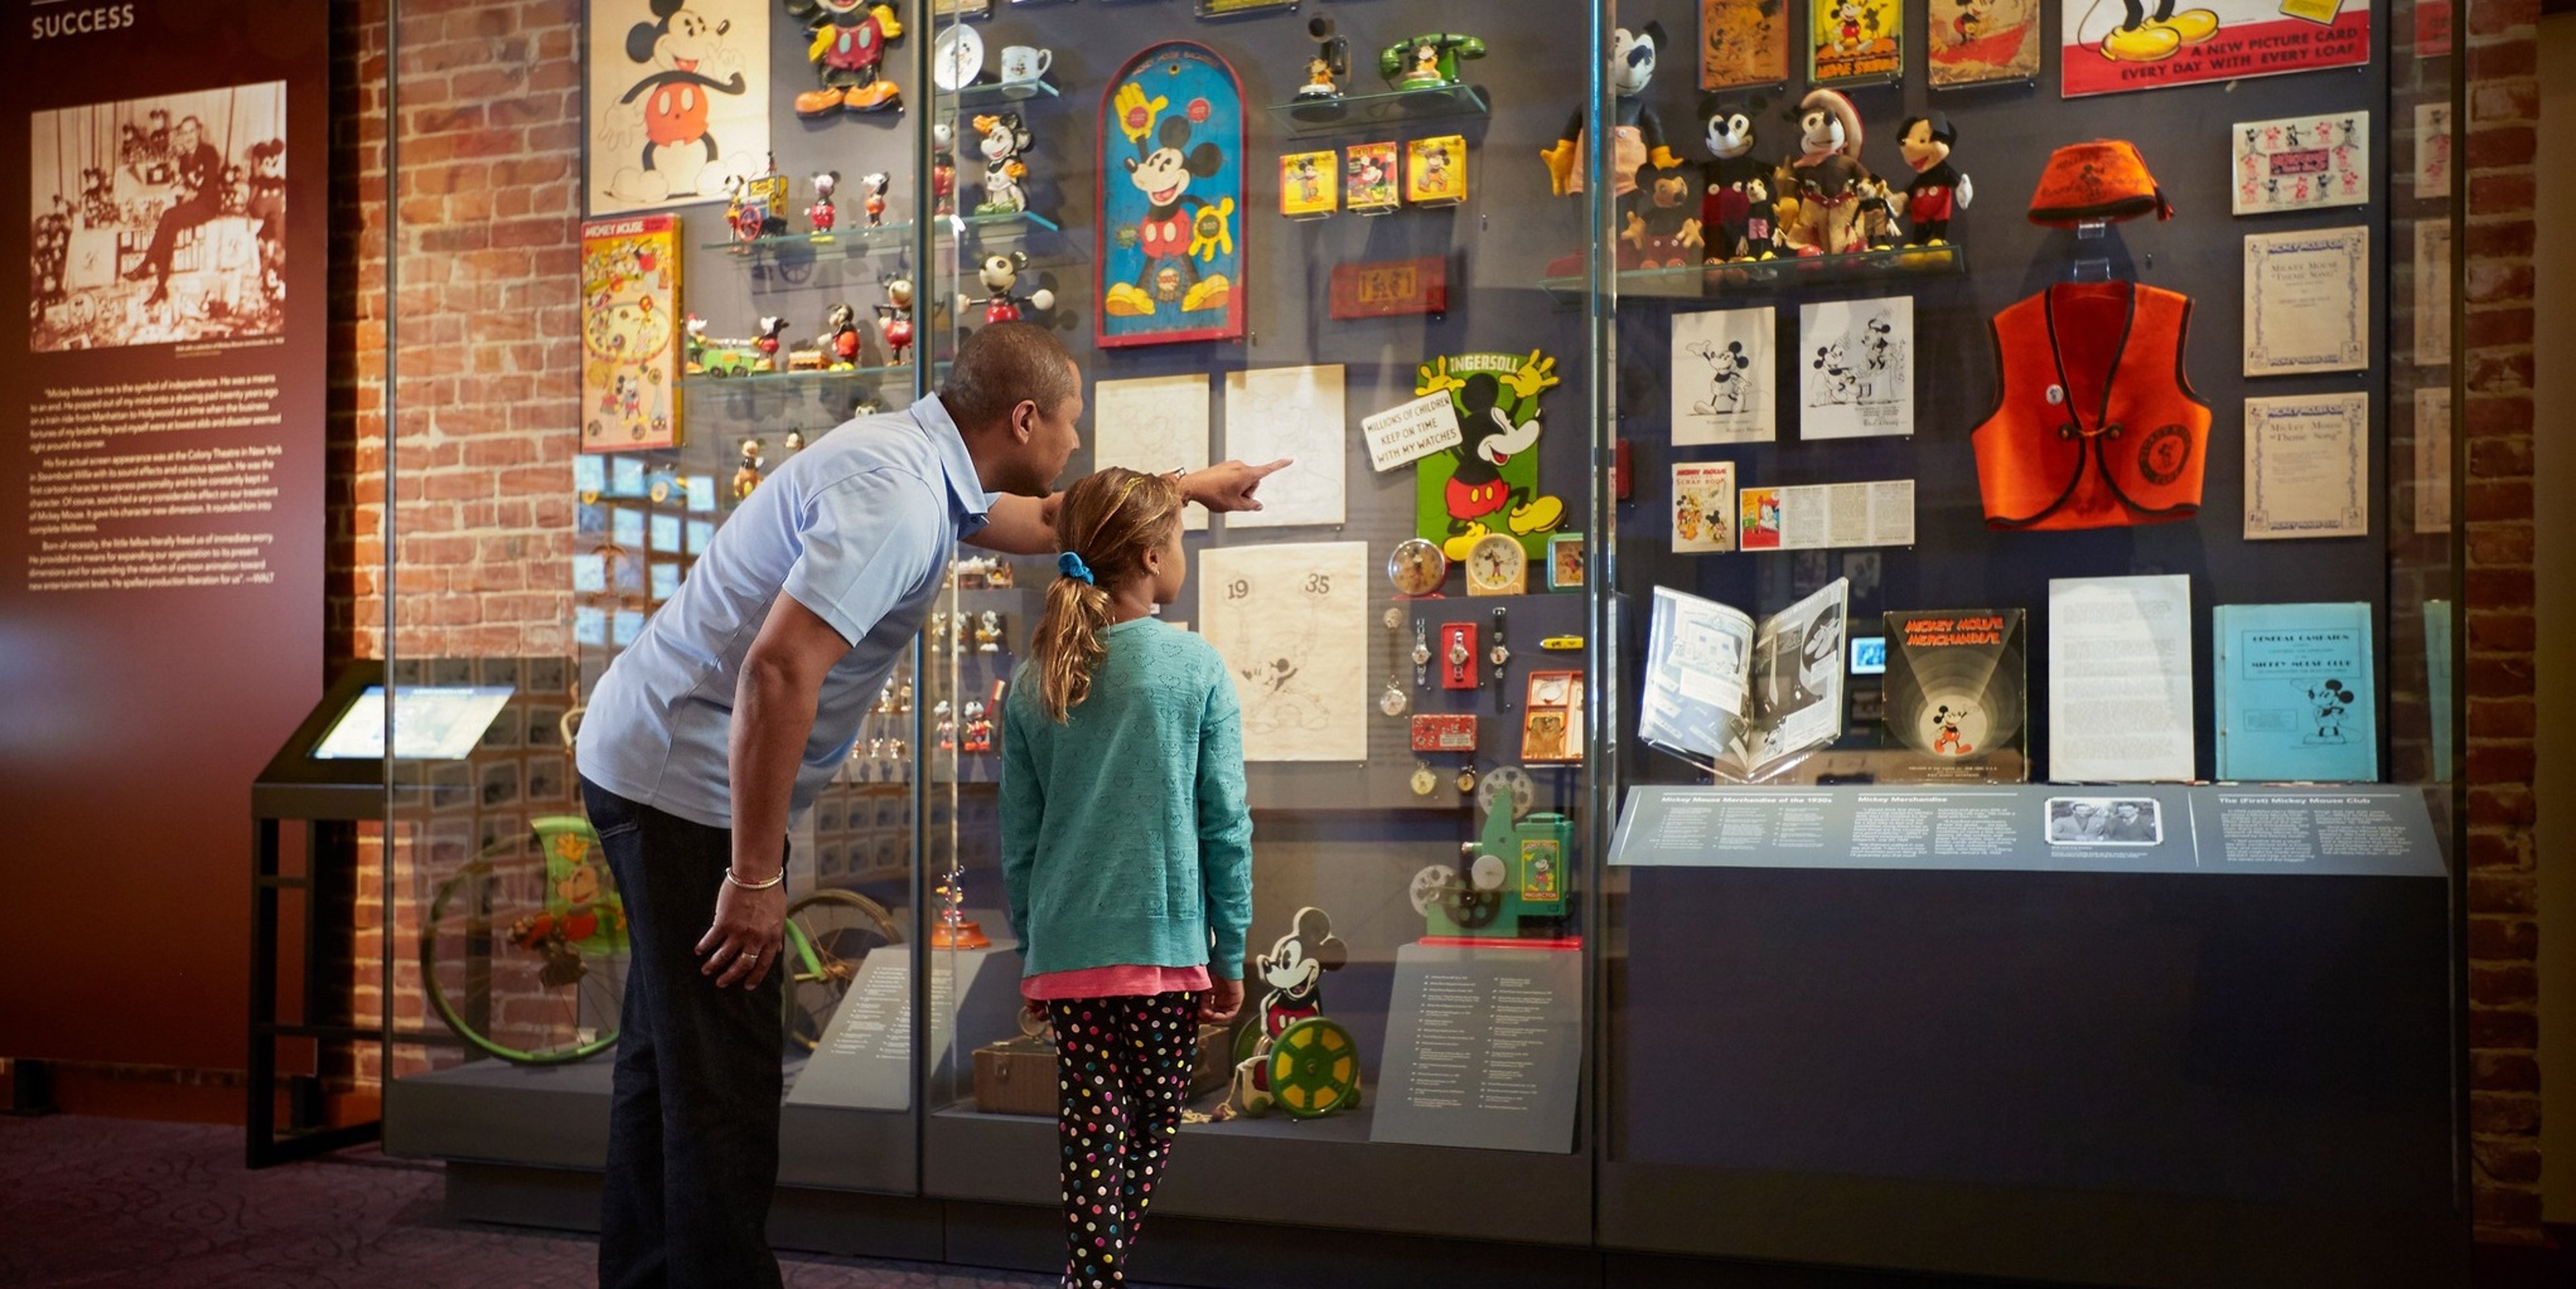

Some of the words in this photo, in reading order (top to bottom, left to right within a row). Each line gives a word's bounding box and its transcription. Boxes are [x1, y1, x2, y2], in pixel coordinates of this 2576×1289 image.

[32, 4, 134, 40] SUCCESS
[2190, 47, 2202, 58] A
[2206, 43, 2241, 56] NEW
[2249, 33, 2309, 50] PICTURE
[2316, 27, 2358, 42] CARD
[2121, 65, 2165, 80] EVERY
[2173, 62, 2201, 74] DAY
[2210, 55, 2251, 68] WITH
[2261, 48, 2307, 63] EVERY
[2315, 43, 2355, 57] LOAF
[1450, 355, 1518, 374] INGERSOLL
[1367, 414, 1403, 433] MILLIONS
[1403, 409, 1413, 423] OF
[1414, 396, 1451, 417] CHILDREN
[1381, 431, 1401, 446] KEEP
[1402, 426, 1415, 439] ON
[1417, 418, 1438, 433] TIME
[1377, 449, 1401, 463] WITH
[1402, 443, 1415, 457] MY
[1417, 428, 1457, 450] WATCHES
[1228, 579, 1249, 600] 19
[1305, 573, 1330, 594] 35
[1904, 620, 1953, 632] MICKEY
[1957, 617, 2004, 630] MOUSE
[1907, 632, 2000, 646] MERCHANDISE
[1661, 796, 1692, 804] Mickey
